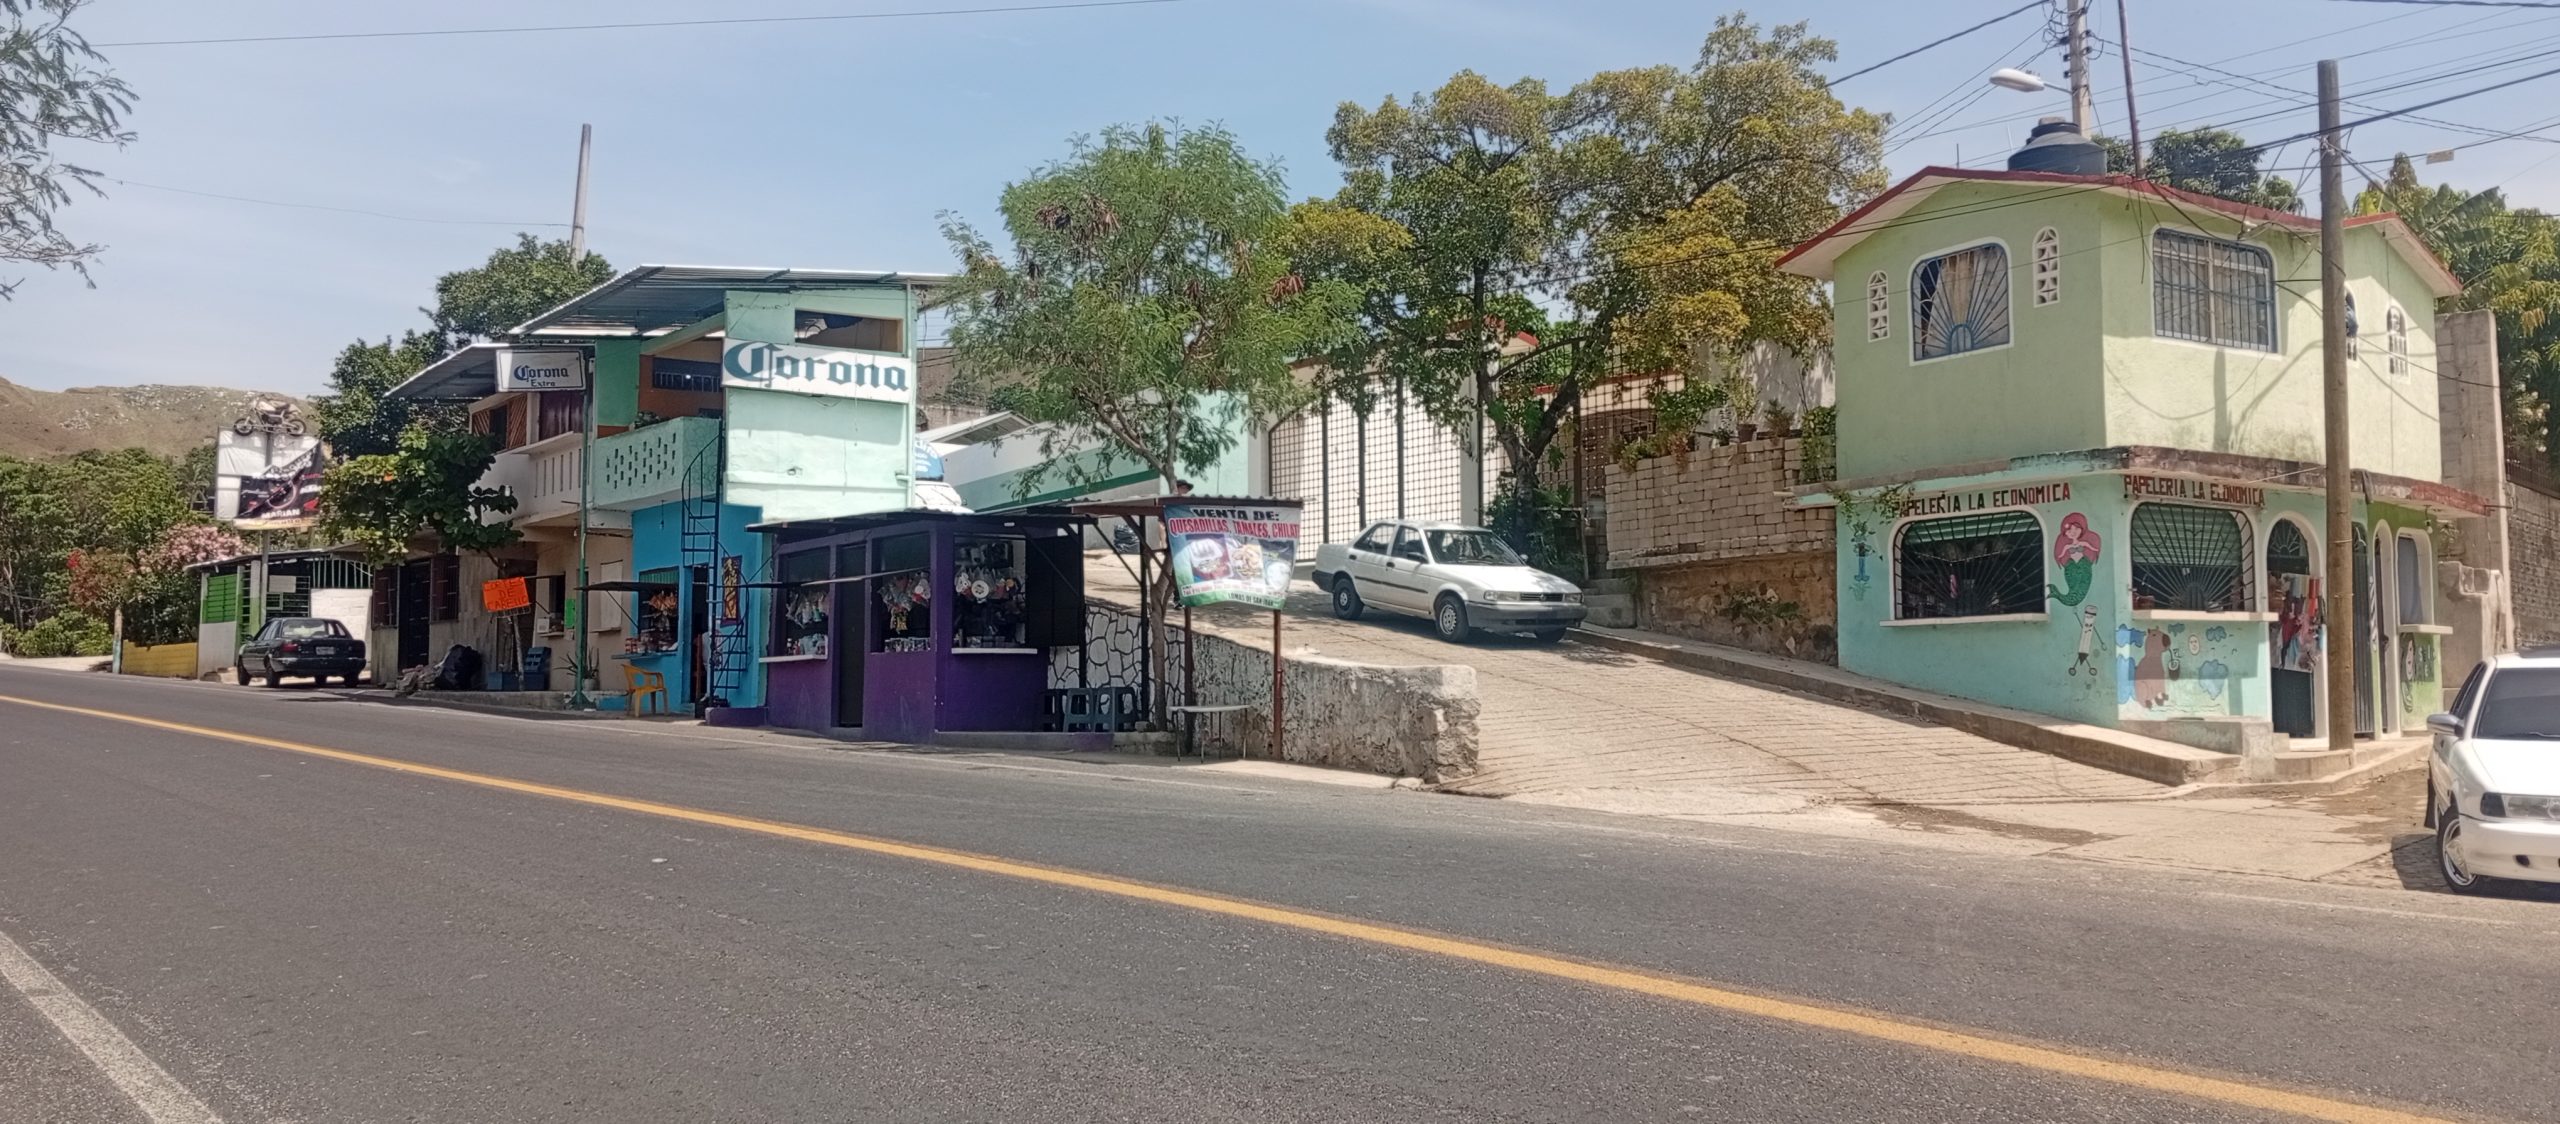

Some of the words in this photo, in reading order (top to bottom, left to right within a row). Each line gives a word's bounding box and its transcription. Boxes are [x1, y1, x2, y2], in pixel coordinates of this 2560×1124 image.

[514, 365, 570, 382] Corona
[724, 341, 909, 392] Corona
[531, 379, 555, 387] Extra
[2124, 474, 2187, 498] PAPELERIA
[2192, 481, 2205, 500] LA
[1968, 493, 1985, 511] LA
[1993, 483, 2071, 508] ECONOMICA
[1193, 509, 1248, 520] VENTA
[1253, 511, 1279, 521] DE:
[1170, 518, 1232, 536] QUESADILLAS,
[497, 588, 516, 600] DE
